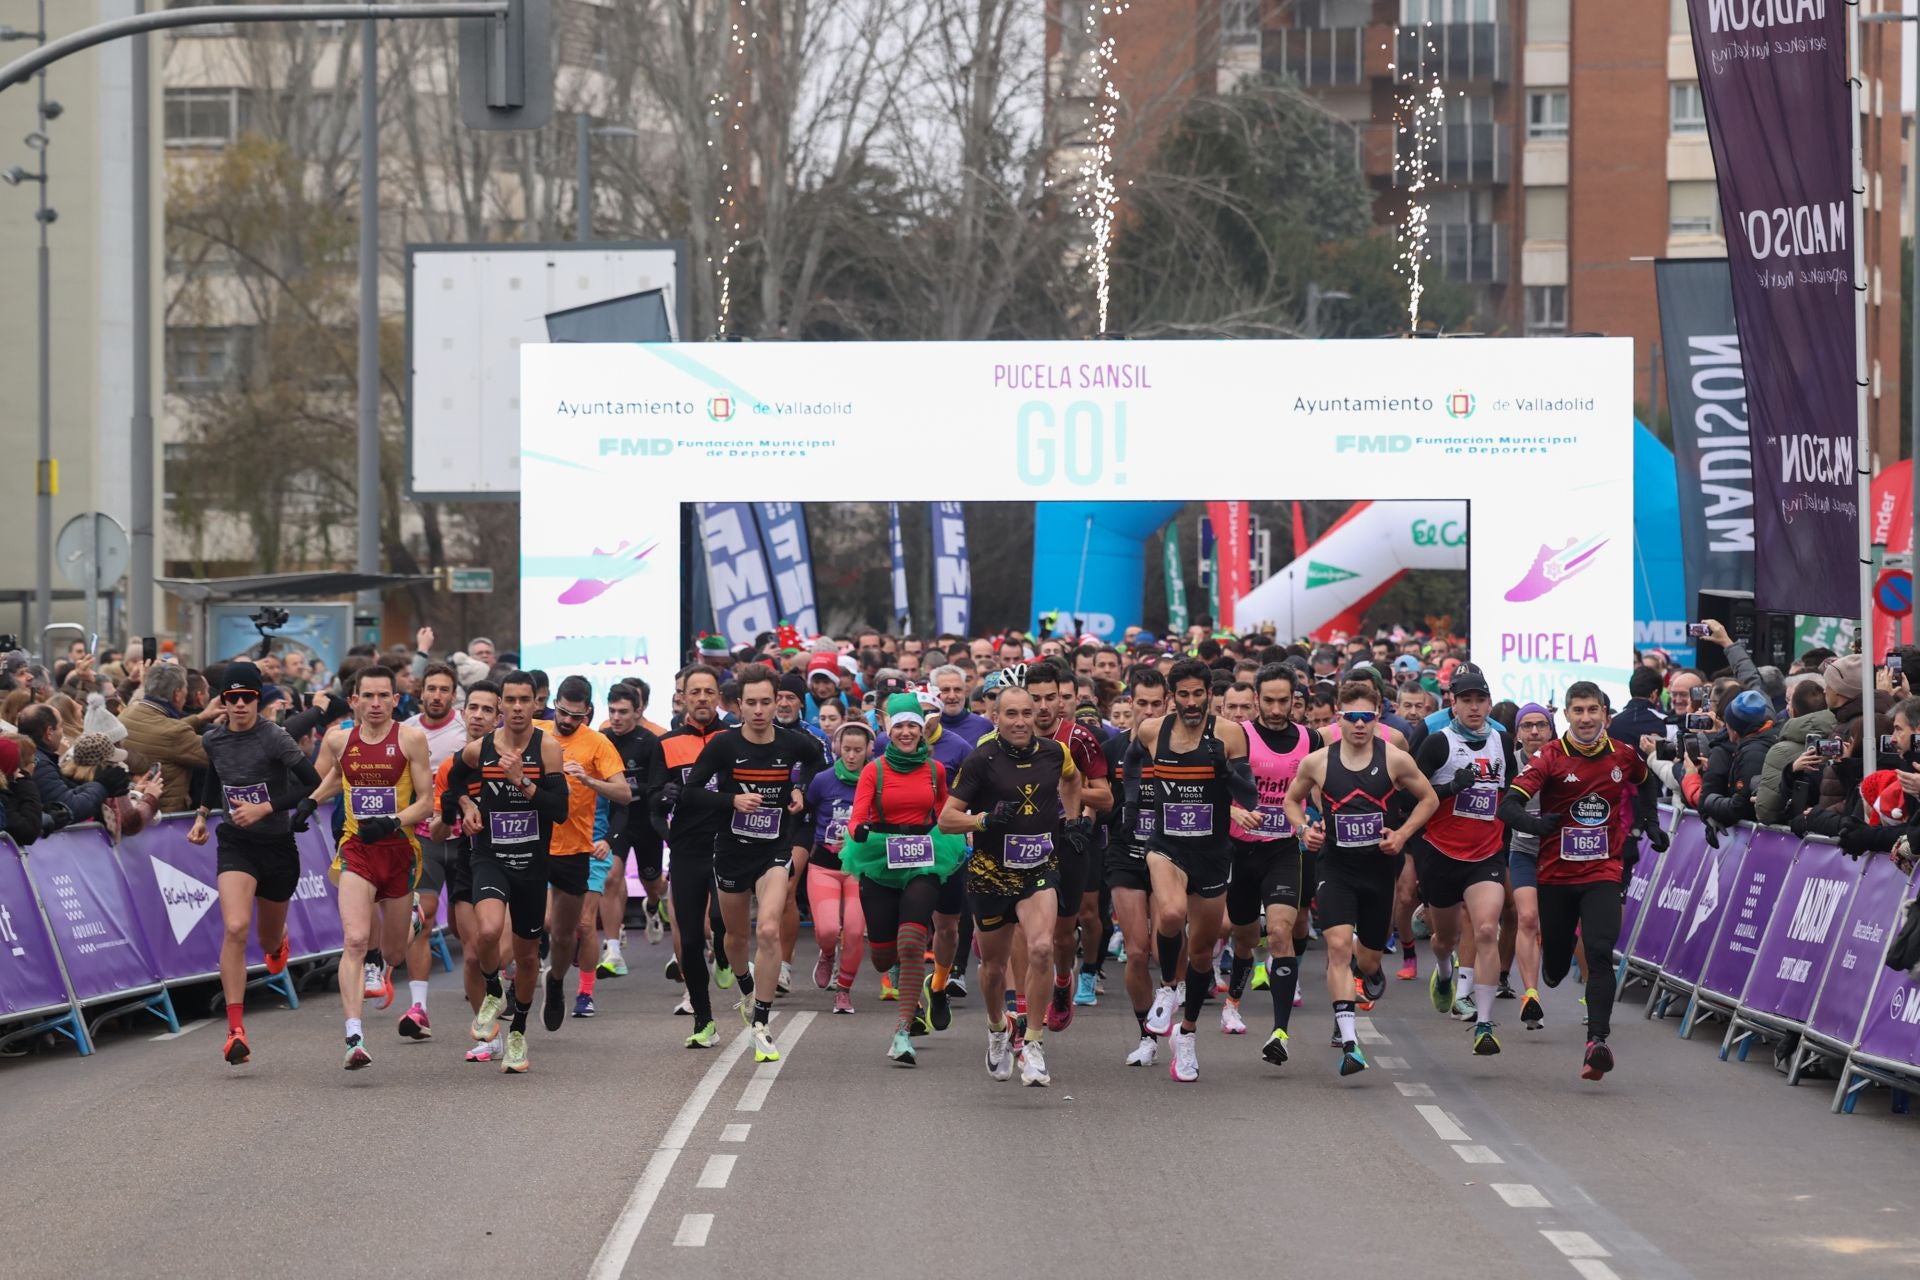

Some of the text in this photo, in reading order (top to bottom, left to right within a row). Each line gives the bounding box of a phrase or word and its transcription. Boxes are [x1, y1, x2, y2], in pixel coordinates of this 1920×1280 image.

[994, 364, 1152, 389] PUCELA SANSIL
[557, 400, 852, 418] Ayuntamiento de Valladolid
[1293, 396, 1594, 415] Ayuntamiento de Valladolid
[599, 438, 674, 456] FMD
[677, 439, 836, 448] Fundación Municipal
[1017, 400, 1128, 486] GO!
[1336, 435, 1412, 453] FMD
[1416, 435, 1578, 445] Fundación Municipal
[706, 449, 807, 458] de Deportes
[1445, 446, 1547, 455] de Deportes
[1501, 633, 1599, 664] PUCELA
[1025, 784, 1032, 794] S
[1254, 776, 1289, 793] Triatl
[361, 795, 384, 809] 238
[1469, 795, 1490, 809] 768
[1578, 802, 1605, 810] Estrella
[1024, 805, 1033, 815] R
[1578, 809, 1603, 818] Galicia
[744, 814, 772, 828] 1059
[1181, 812, 1196, 825] 32
[501, 820, 529, 833] 1727
[1345, 822, 1375, 836] 1913
[898, 843, 925, 857] 1369
[1572, 836, 1601, 850] 1652
[1019, 844, 1042, 857] 729
[72, 921, 107, 939] AQUAVALL
